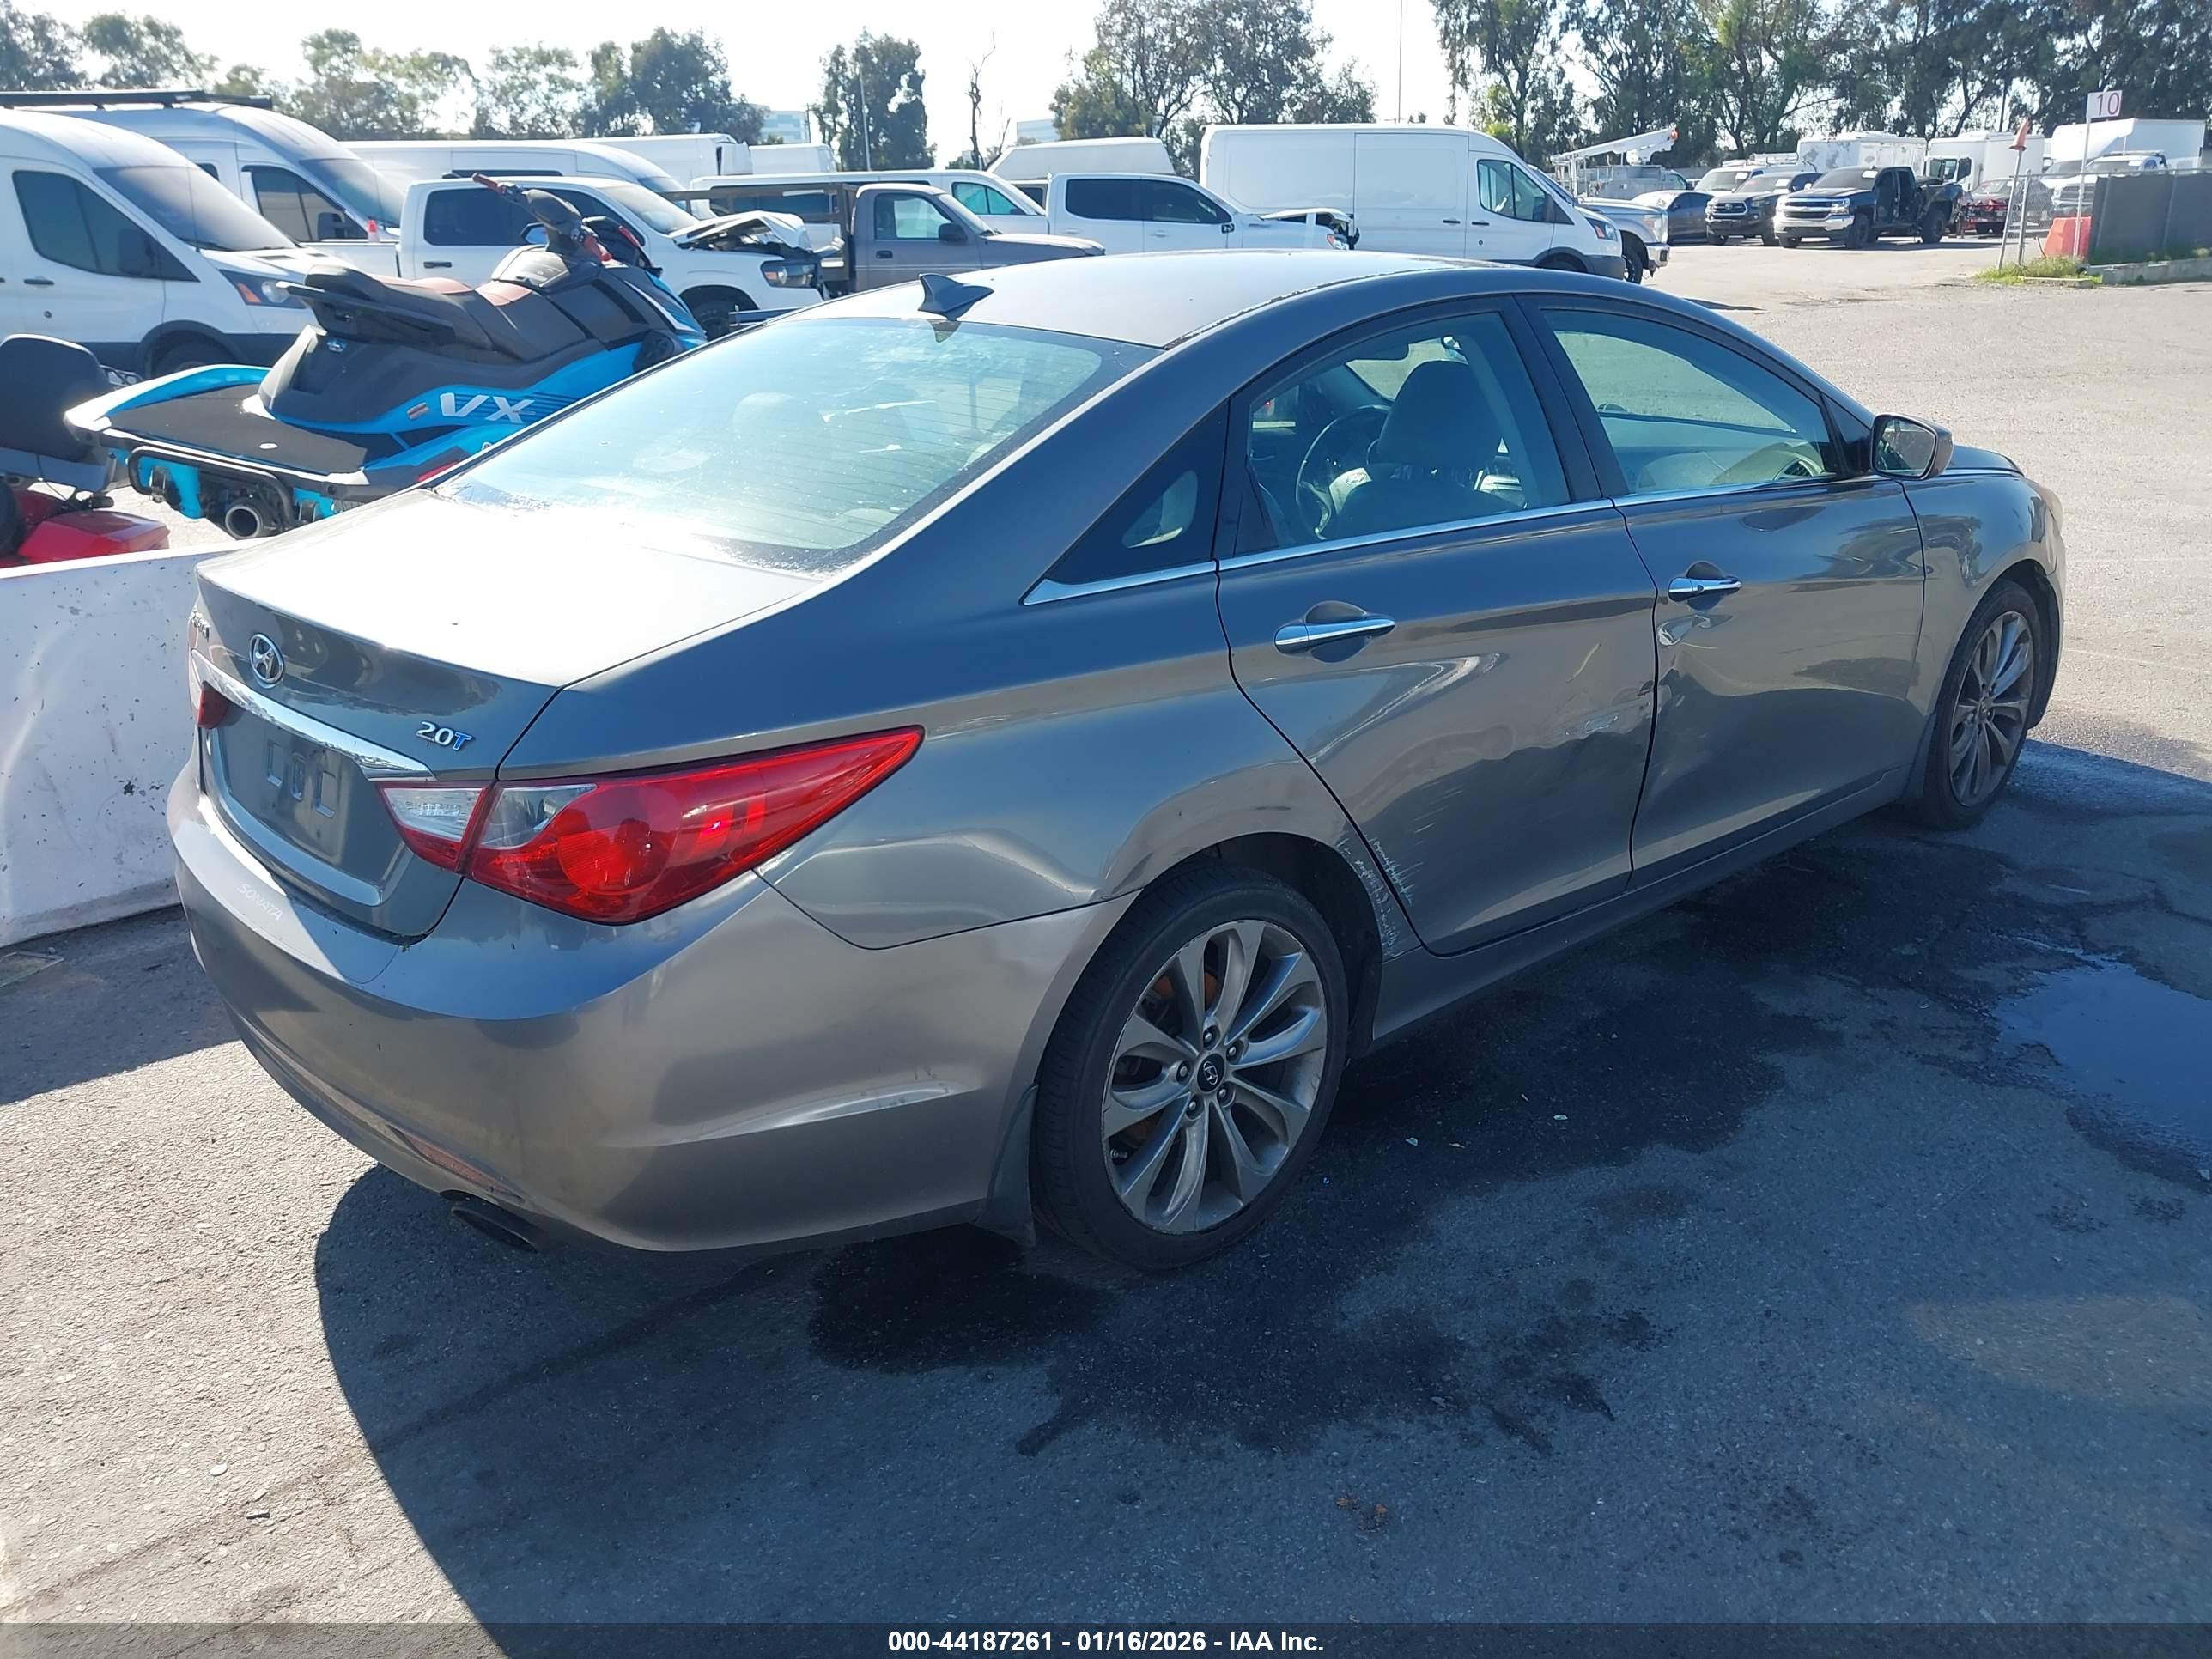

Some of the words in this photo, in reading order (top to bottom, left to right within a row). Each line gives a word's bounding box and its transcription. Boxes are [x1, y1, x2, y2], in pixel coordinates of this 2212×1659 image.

[2097, 92, 2120, 116] 10
[440, 392, 536, 424] VX
[236, 883, 283, 921] SONATA
